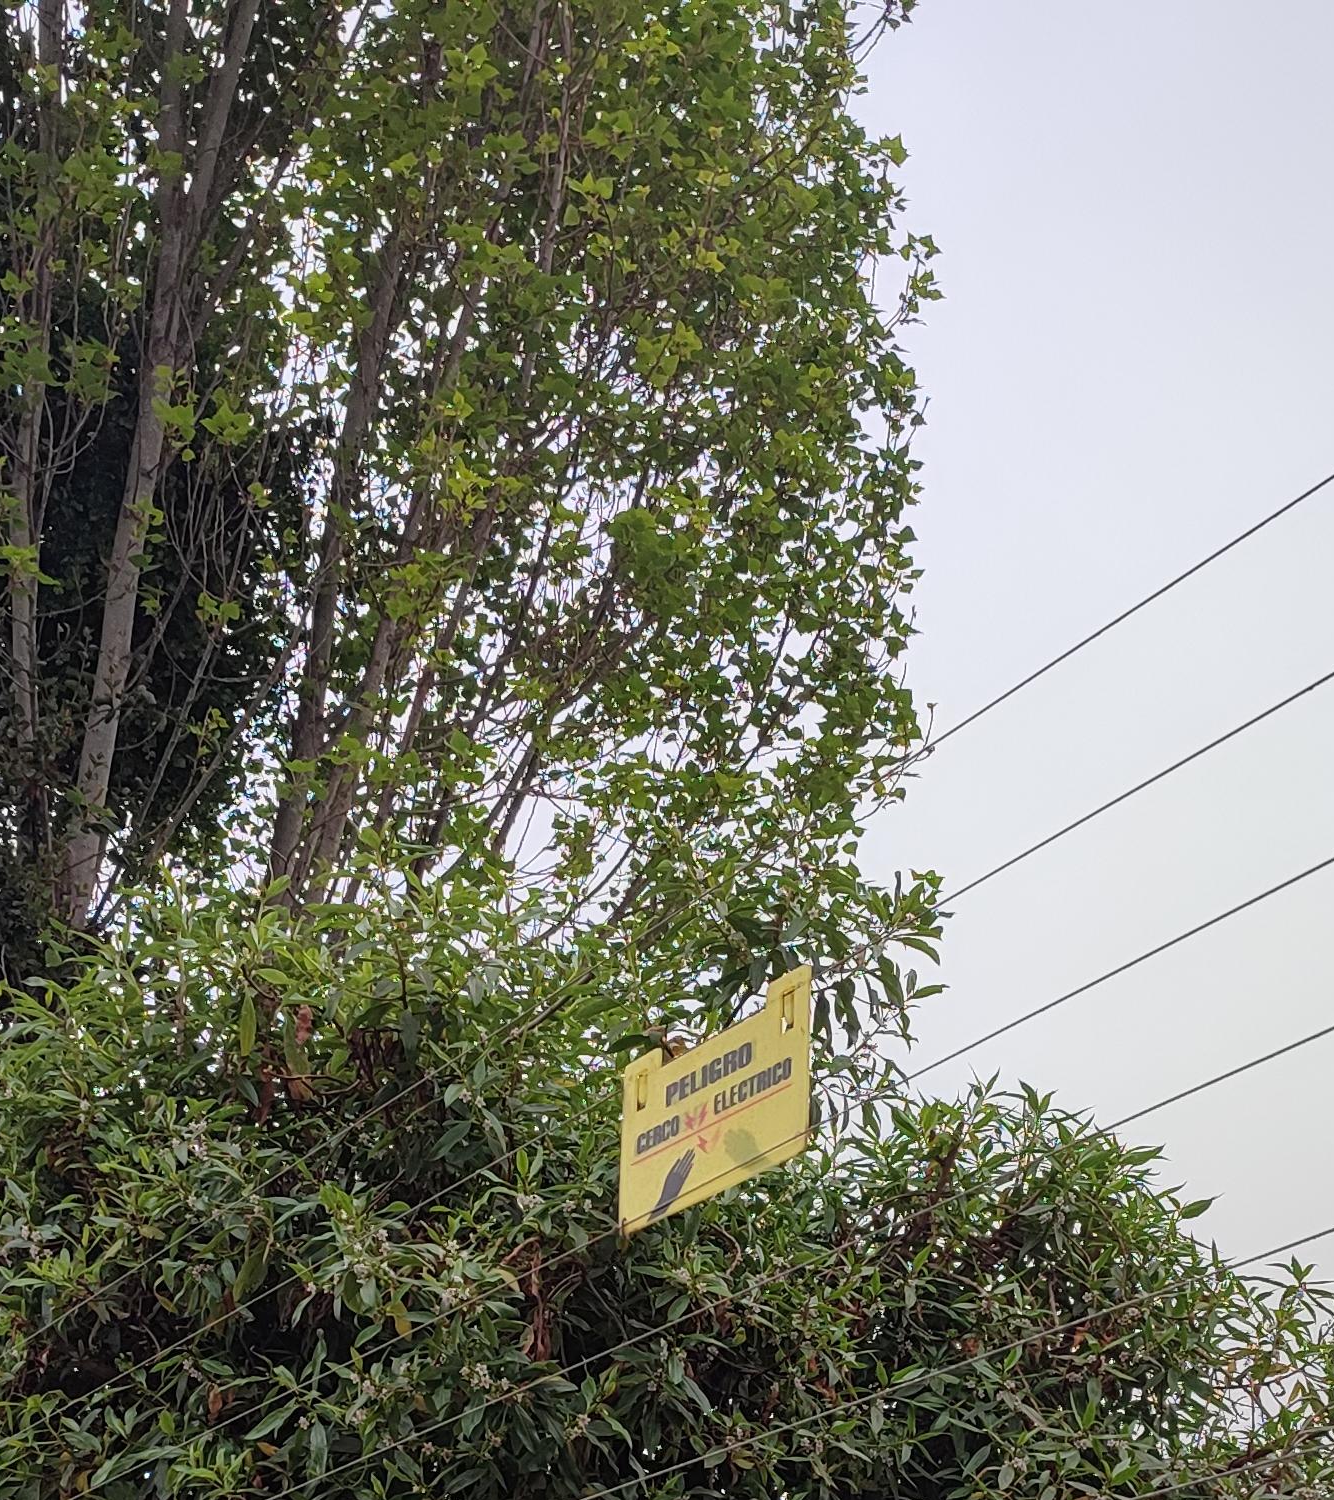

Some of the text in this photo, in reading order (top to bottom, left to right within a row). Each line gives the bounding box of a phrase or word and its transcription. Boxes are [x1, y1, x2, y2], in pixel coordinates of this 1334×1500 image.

[636, 1057, 792, 1155] CERCO ELECTRICO
[665, 1042, 752, 1107] PELIGRO
